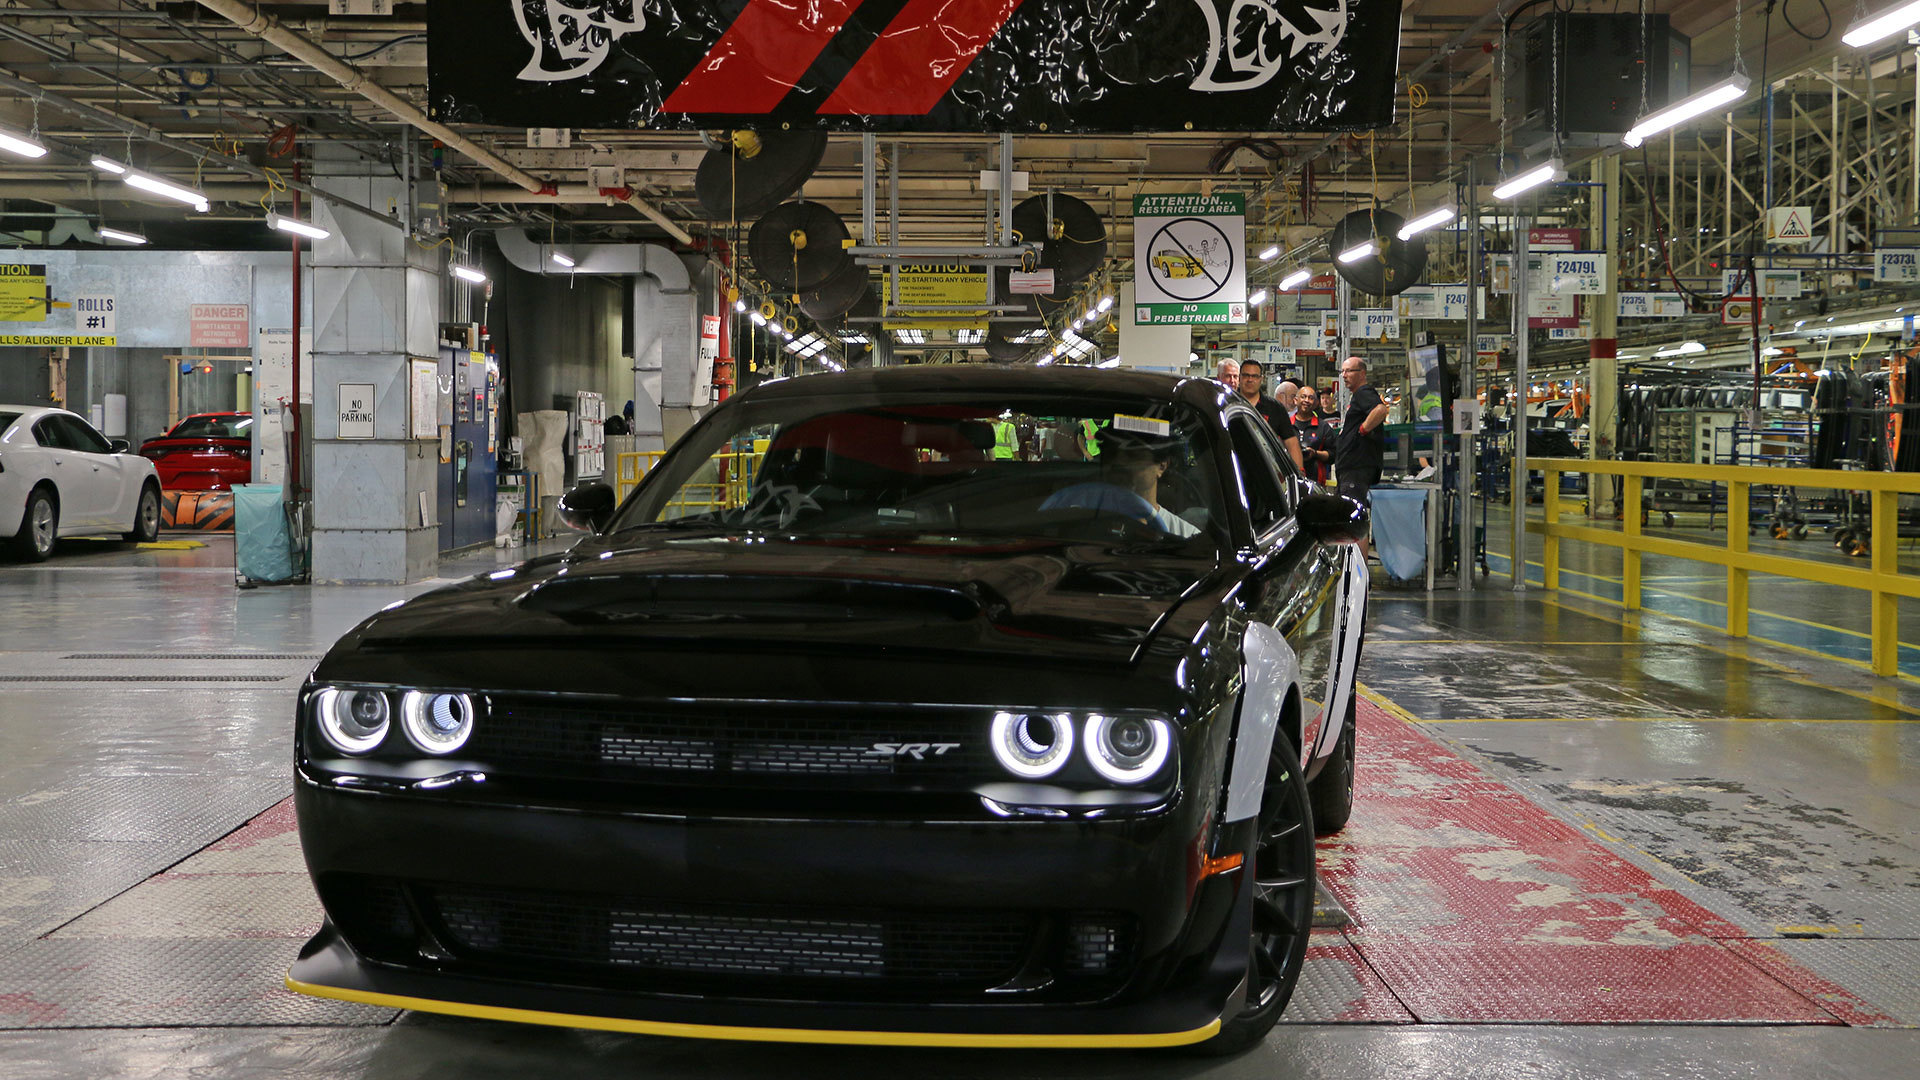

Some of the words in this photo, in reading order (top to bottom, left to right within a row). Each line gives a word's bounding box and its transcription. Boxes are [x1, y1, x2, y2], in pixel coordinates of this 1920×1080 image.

[1141, 196, 1233, 206] ATTENTION...
[1138, 205, 1205, 214] RESTRICTED
[1208, 205, 1237, 213] AREA
[1882, 254, 1916, 264] F2373L
[1556, 261, 1596, 274] F2479L
[1446, 294, 1467, 304] F247
[1622, 296, 1646, 304] F2375L
[78, 298, 114, 312] ROLLS
[194, 307, 244, 318] DANGER
[86, 316, 106, 328] #1
[1154, 314, 1228, 322] PEDESTRIANS
[77, 336, 106, 346] LANE
[110, 337, 116, 346] 1
[352, 400, 362, 410] NO
[341, 412, 372, 422] PARKING
[865, 743, 960, 760] SRT
